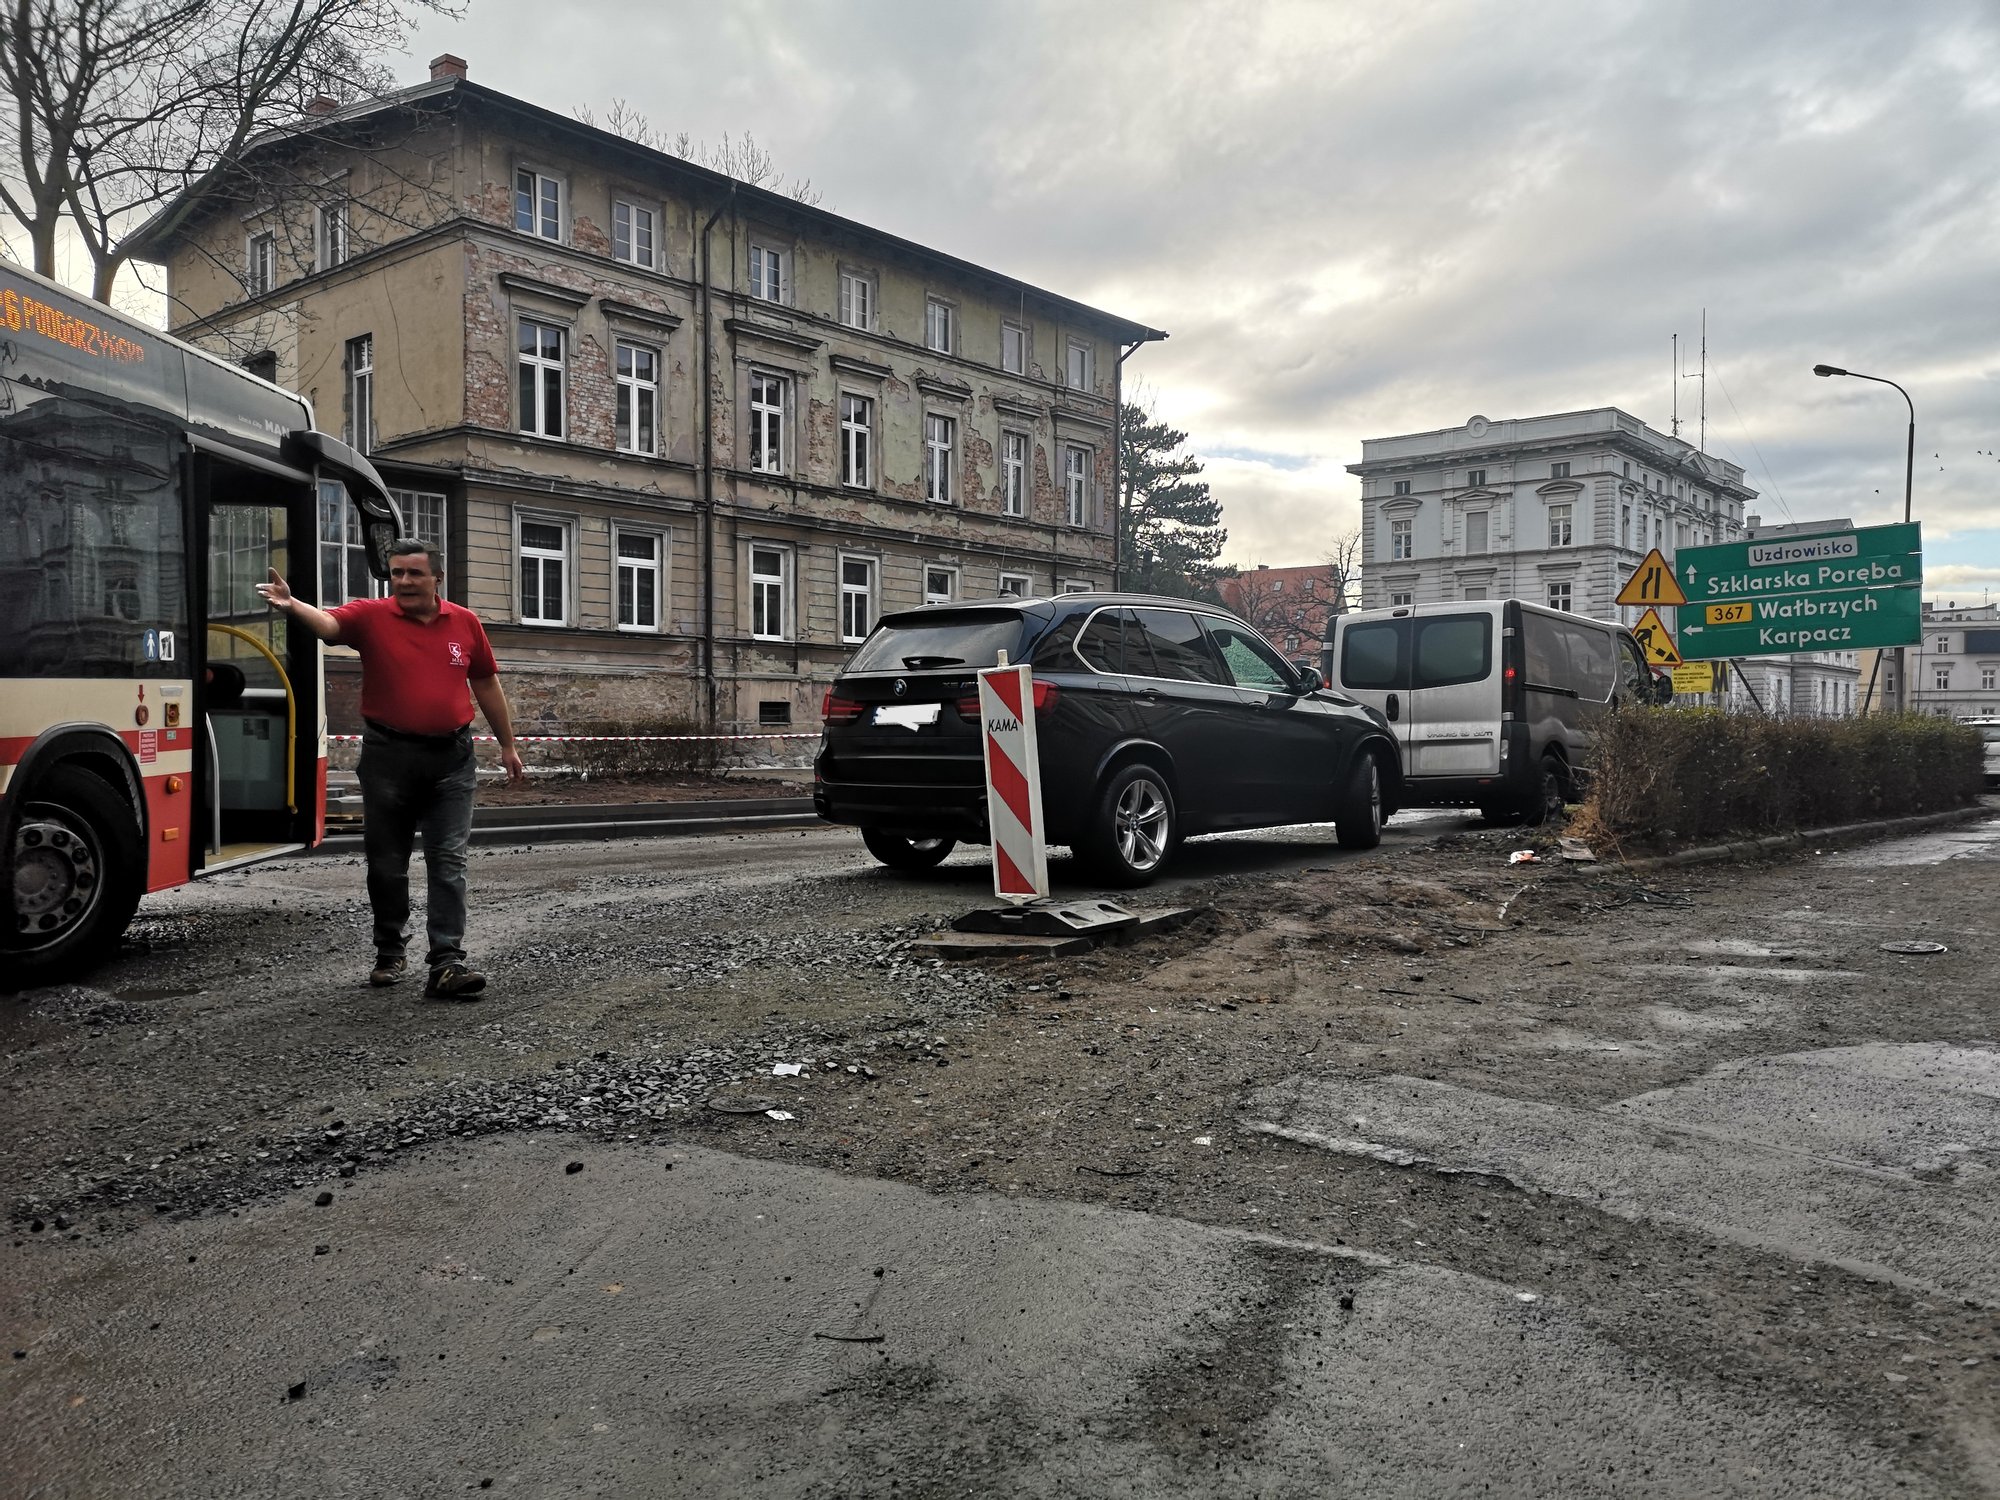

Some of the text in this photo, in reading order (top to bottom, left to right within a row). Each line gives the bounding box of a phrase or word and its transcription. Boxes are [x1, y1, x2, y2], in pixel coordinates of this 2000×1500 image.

[265, 419, 290, 440] MAN
[1753, 541, 1853, 563] Uzdrowisko
[1707, 562, 1902, 595] Szklarska Poręba
[1714, 606, 1744, 622] 367
[1758, 594, 1878, 619] Wałbrzych
[1759, 626, 1851, 647] Karpacz
[988, 718, 1018, 732] KAMA
